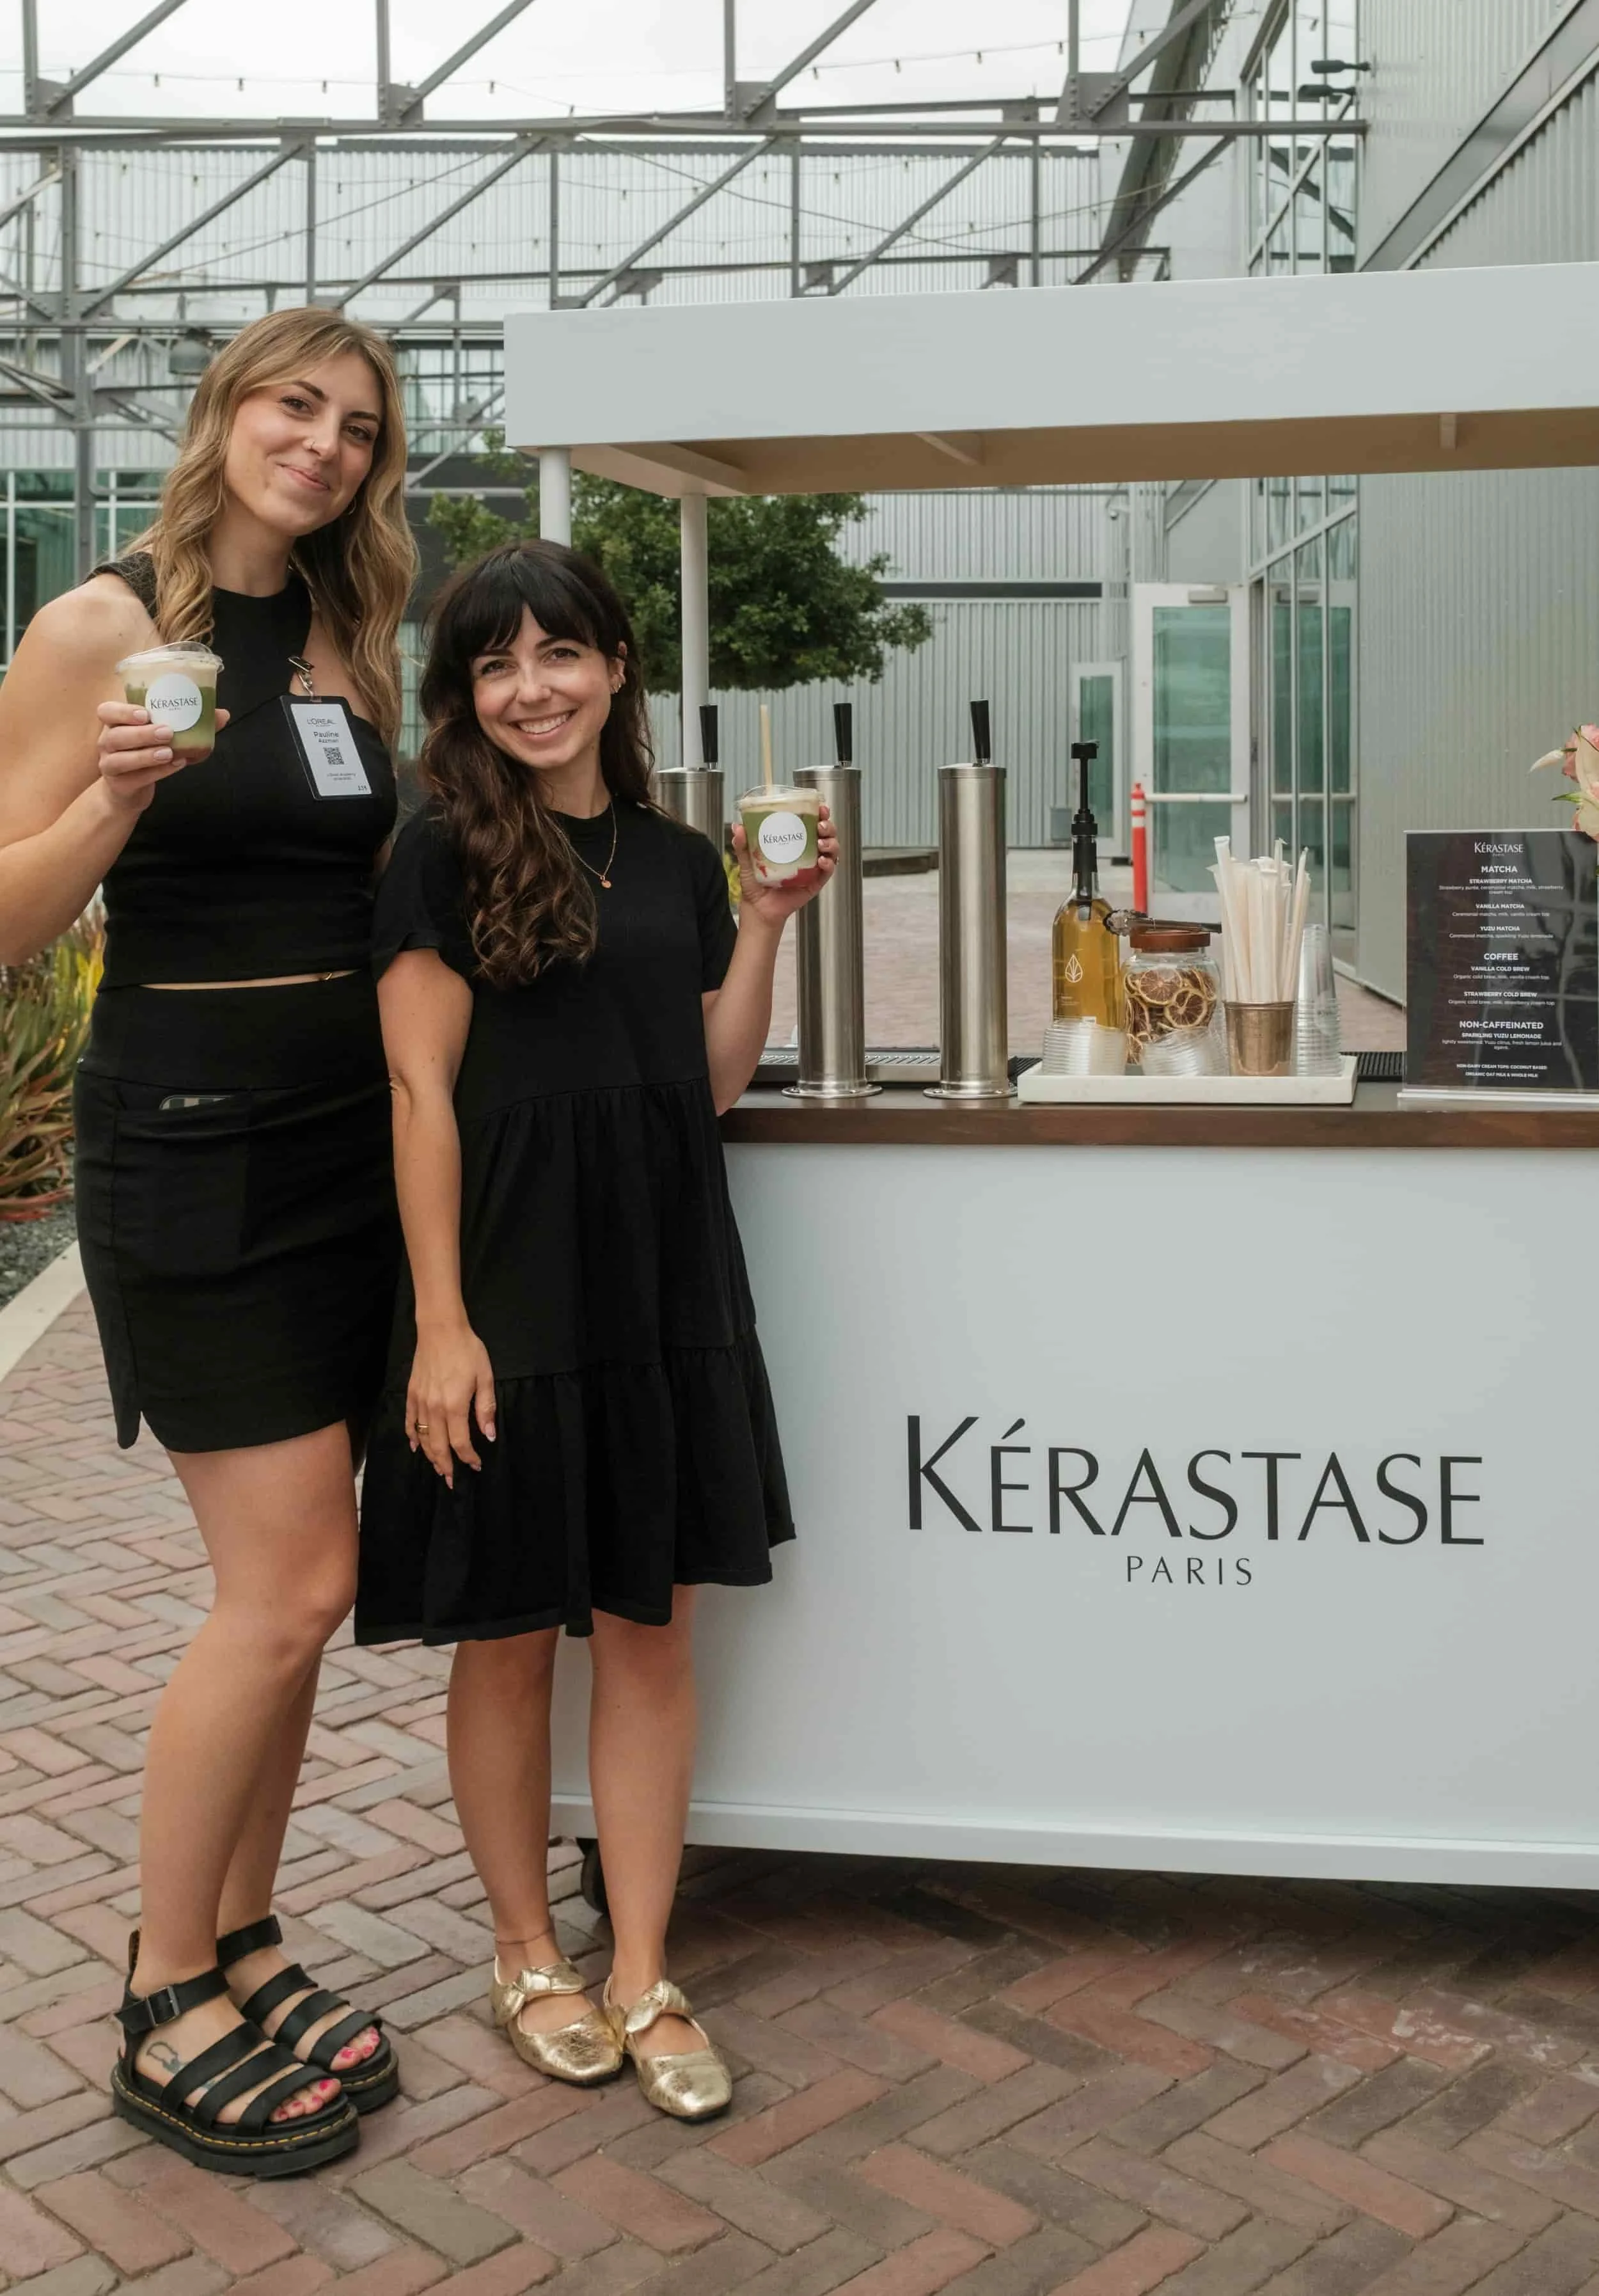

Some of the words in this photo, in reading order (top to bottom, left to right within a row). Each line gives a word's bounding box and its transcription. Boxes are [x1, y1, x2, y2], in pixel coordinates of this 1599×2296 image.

[150, 697, 198, 709] KÉRASTASE
[763, 833, 804, 844] KÉRASTASE
[1474, 842, 1524, 853] KÉRASTASE
[1459, 1021, 1543, 1029] NON-CAFFEINATED
[907, 1414, 1484, 1545] KÉRASTASE
[1126, 1555, 1252, 1585] PARIS
